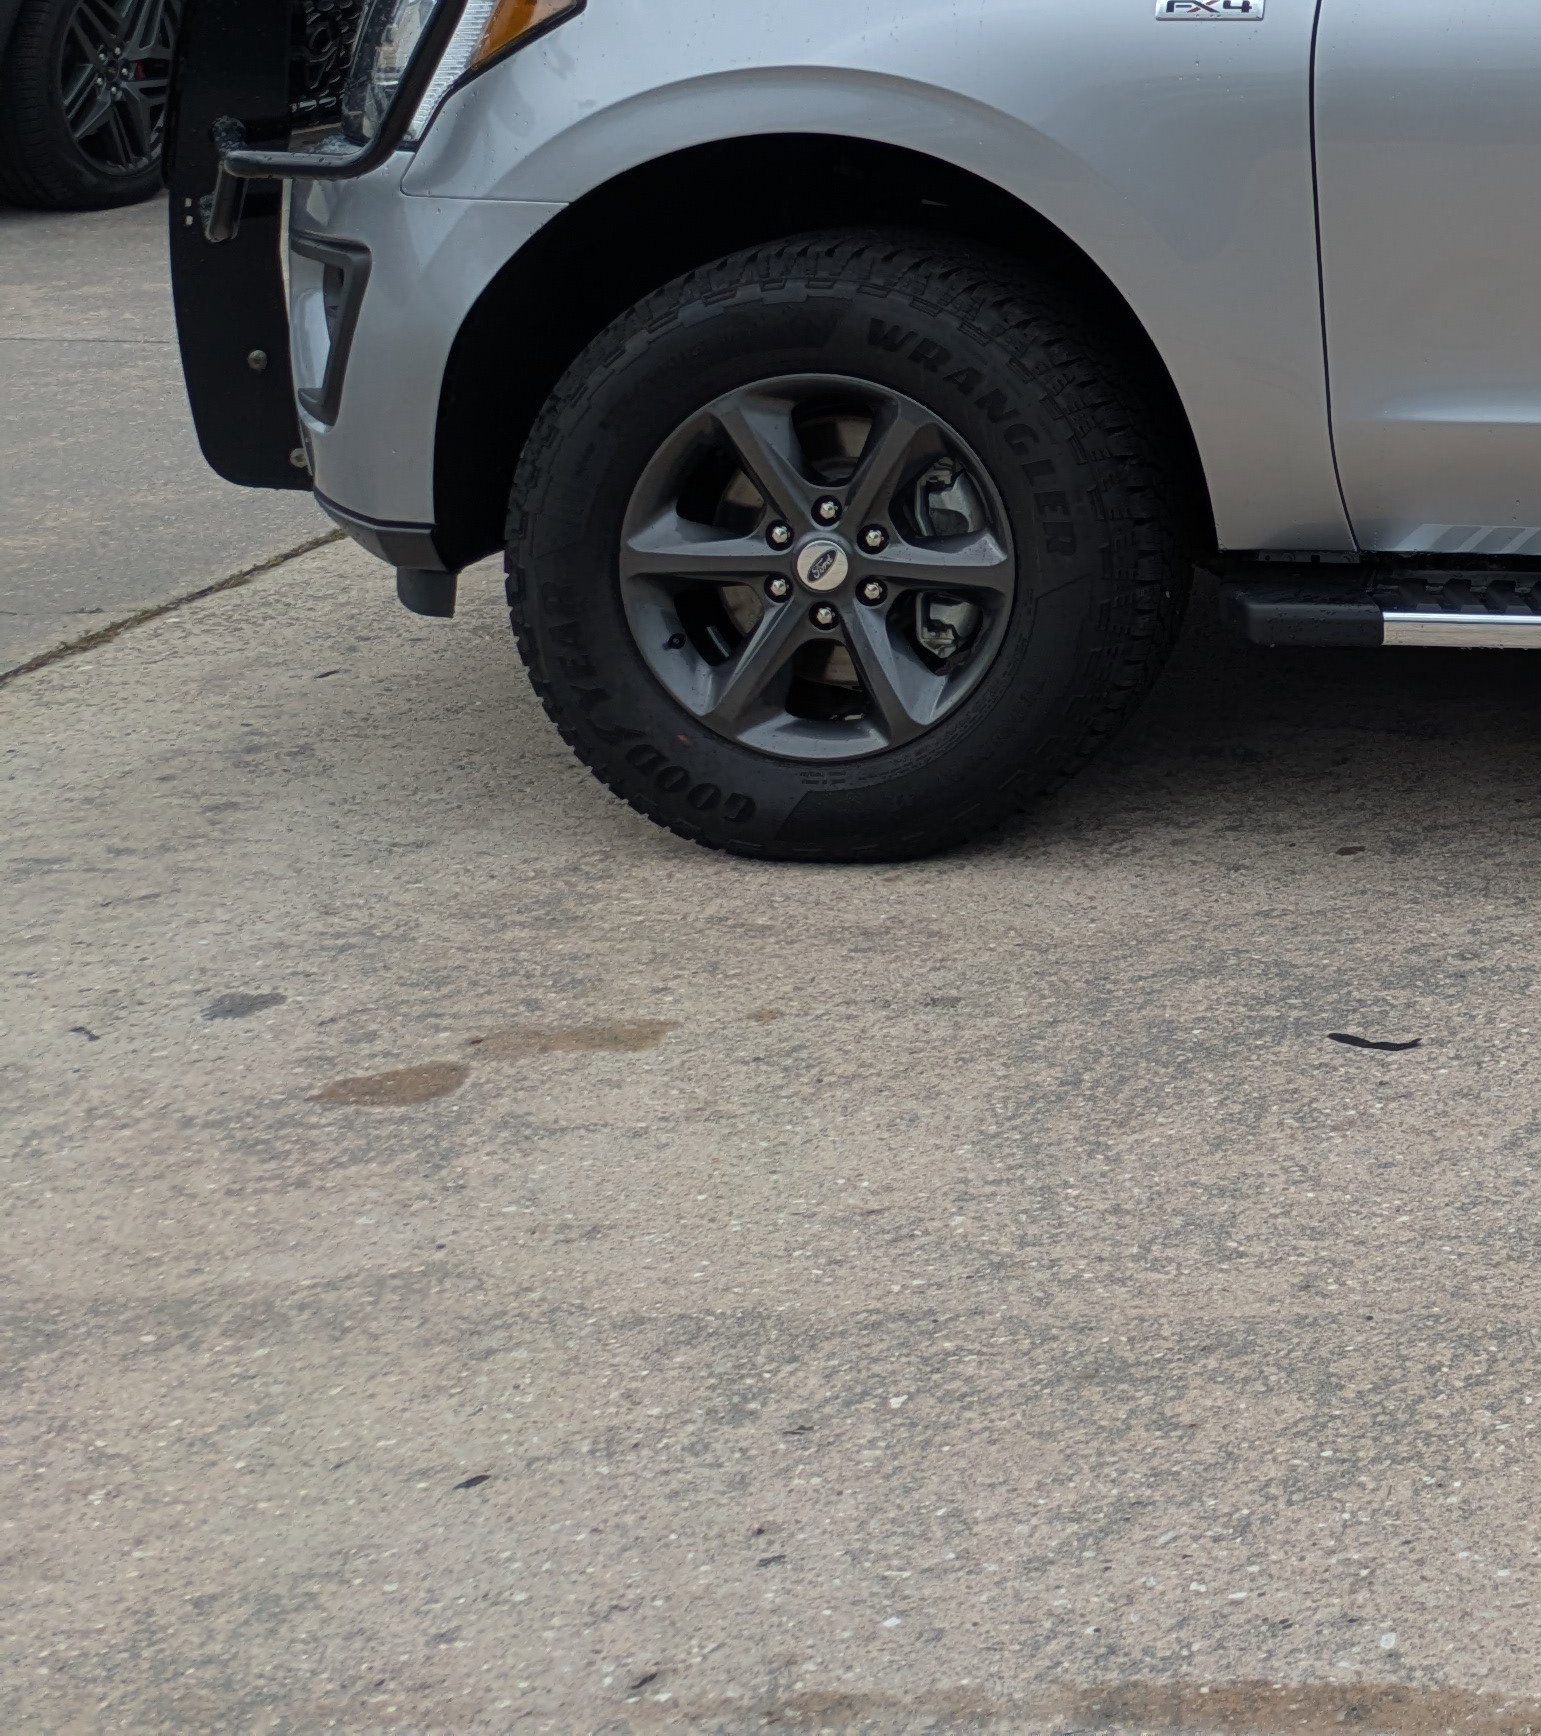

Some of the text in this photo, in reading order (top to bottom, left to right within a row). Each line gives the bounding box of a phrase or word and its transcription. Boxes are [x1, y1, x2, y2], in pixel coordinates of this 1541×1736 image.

[1165, 0, 1253, 13] FX4
[866, 317, 1078, 558] WRANGLER
[811, 553, 833, 579] Ford
